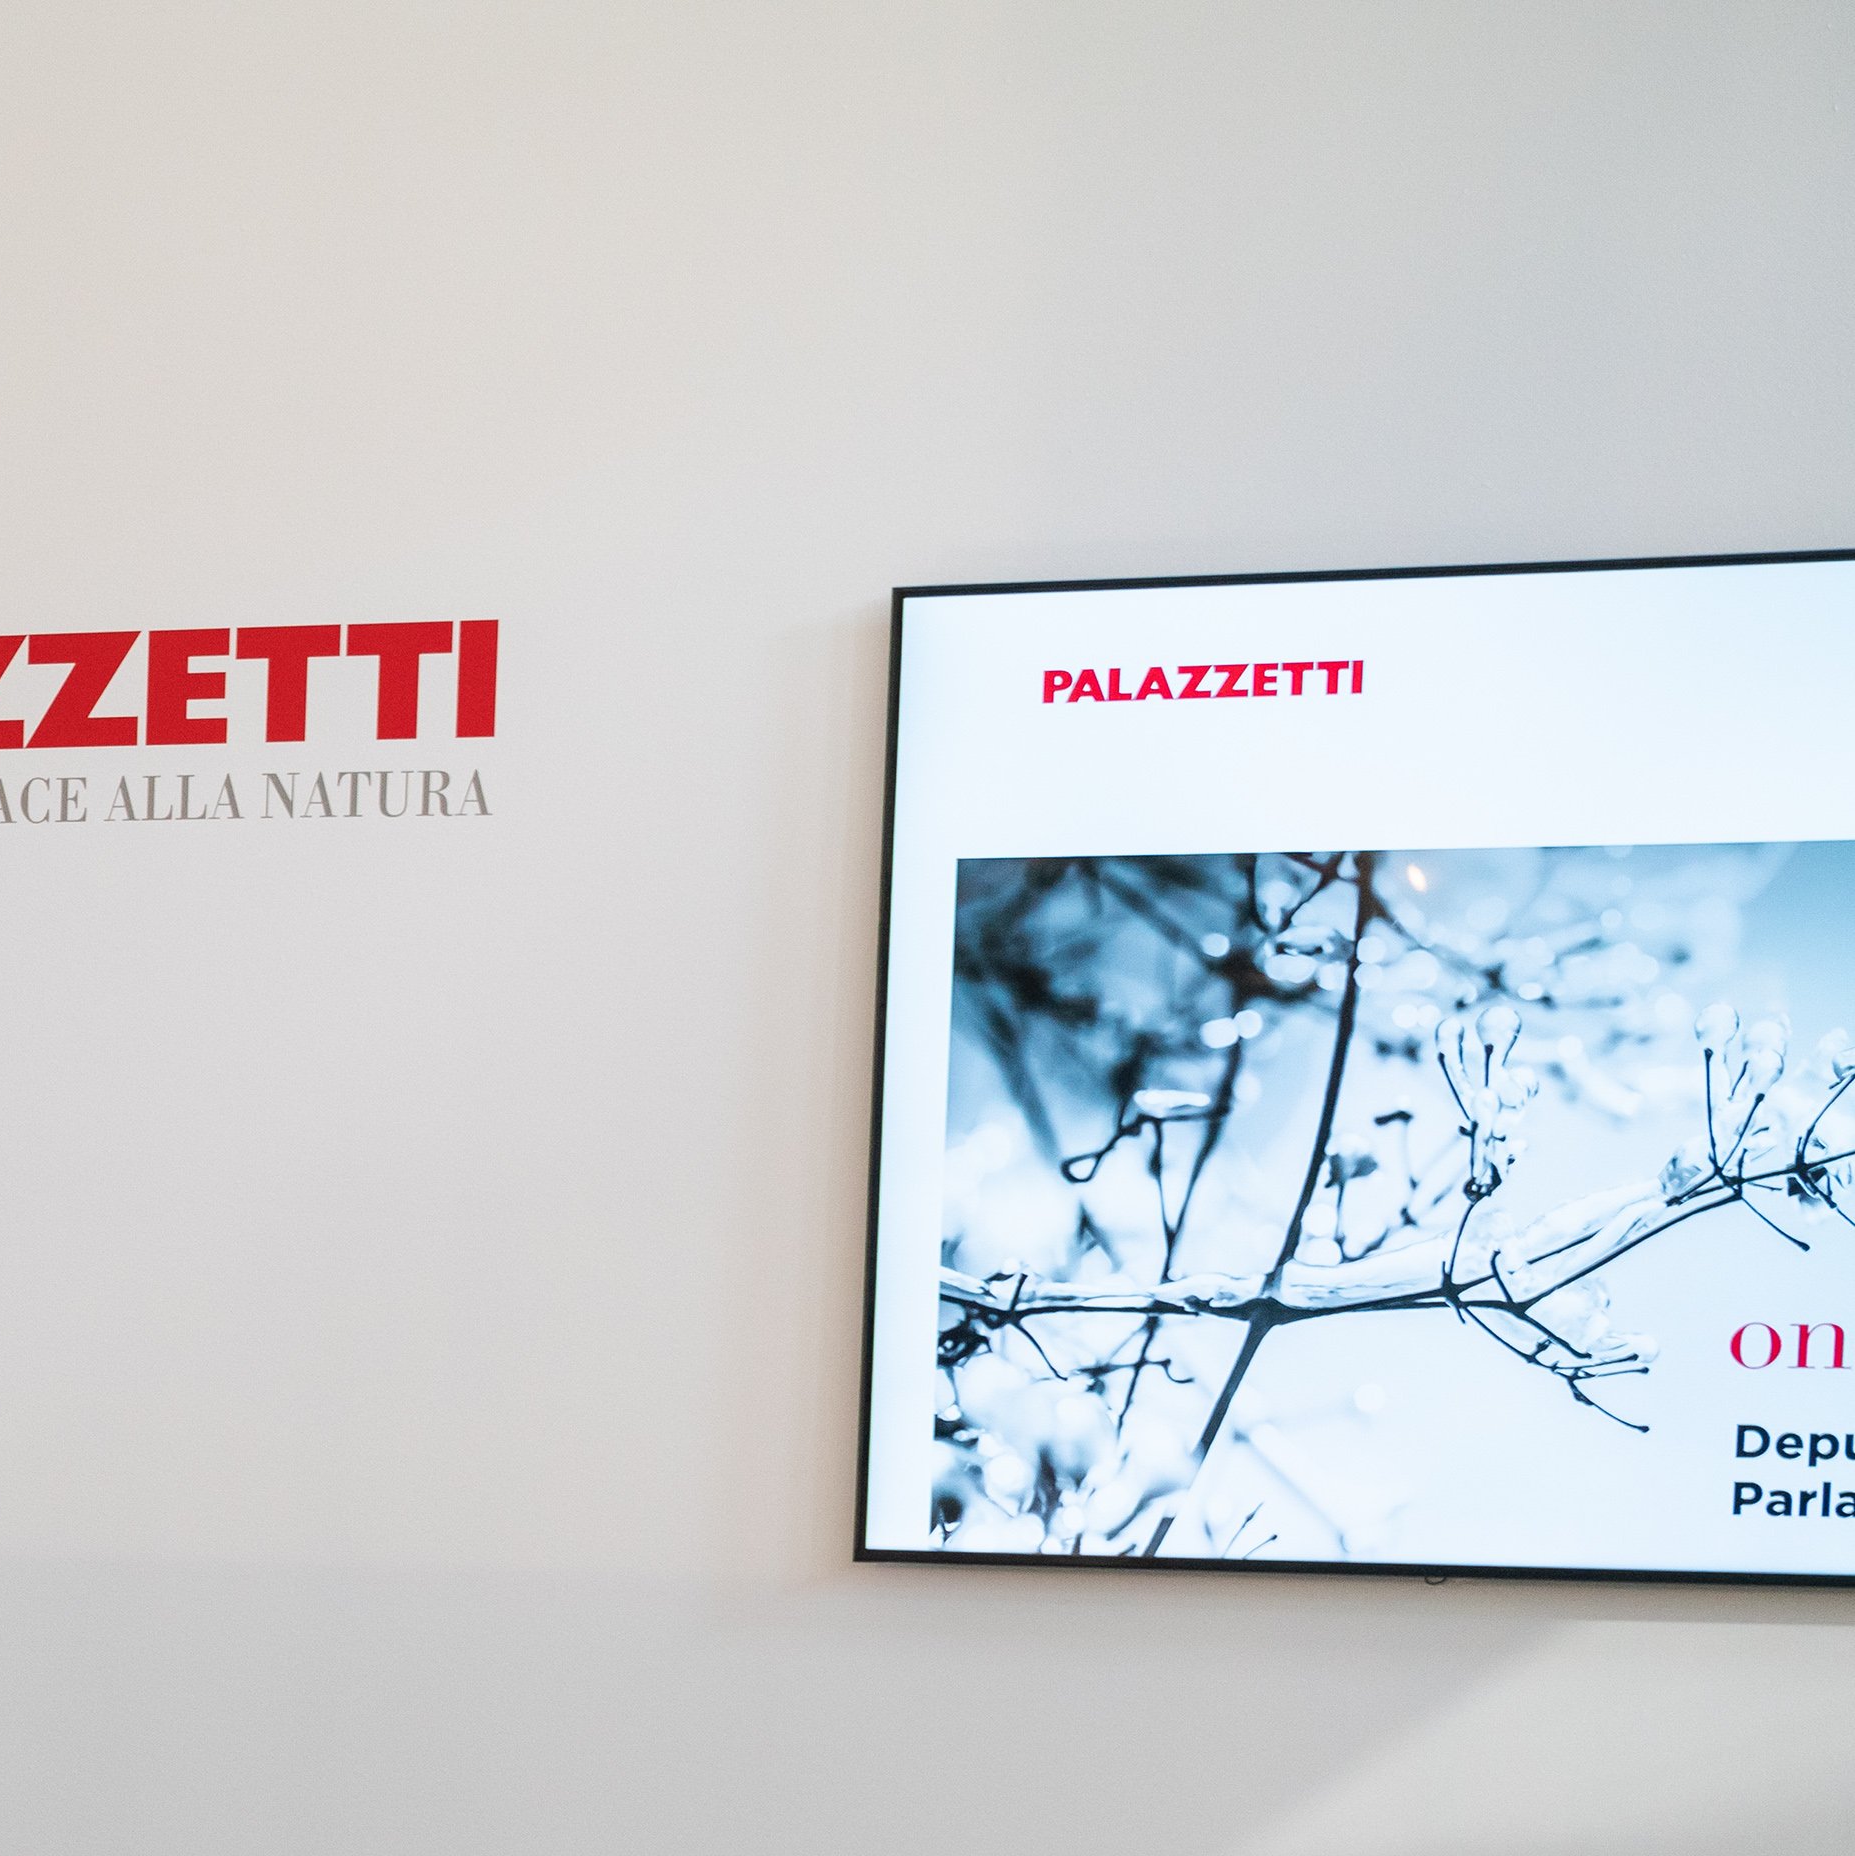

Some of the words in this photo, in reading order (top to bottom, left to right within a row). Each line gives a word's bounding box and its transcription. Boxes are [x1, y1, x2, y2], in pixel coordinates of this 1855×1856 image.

[1041, 659, 1365, 704] PALAZZETTI
[103, 771, 242, 823] ALLA
[261, 767, 493, 820] NATURA
[1729, 1322, 1852, 1370] on
